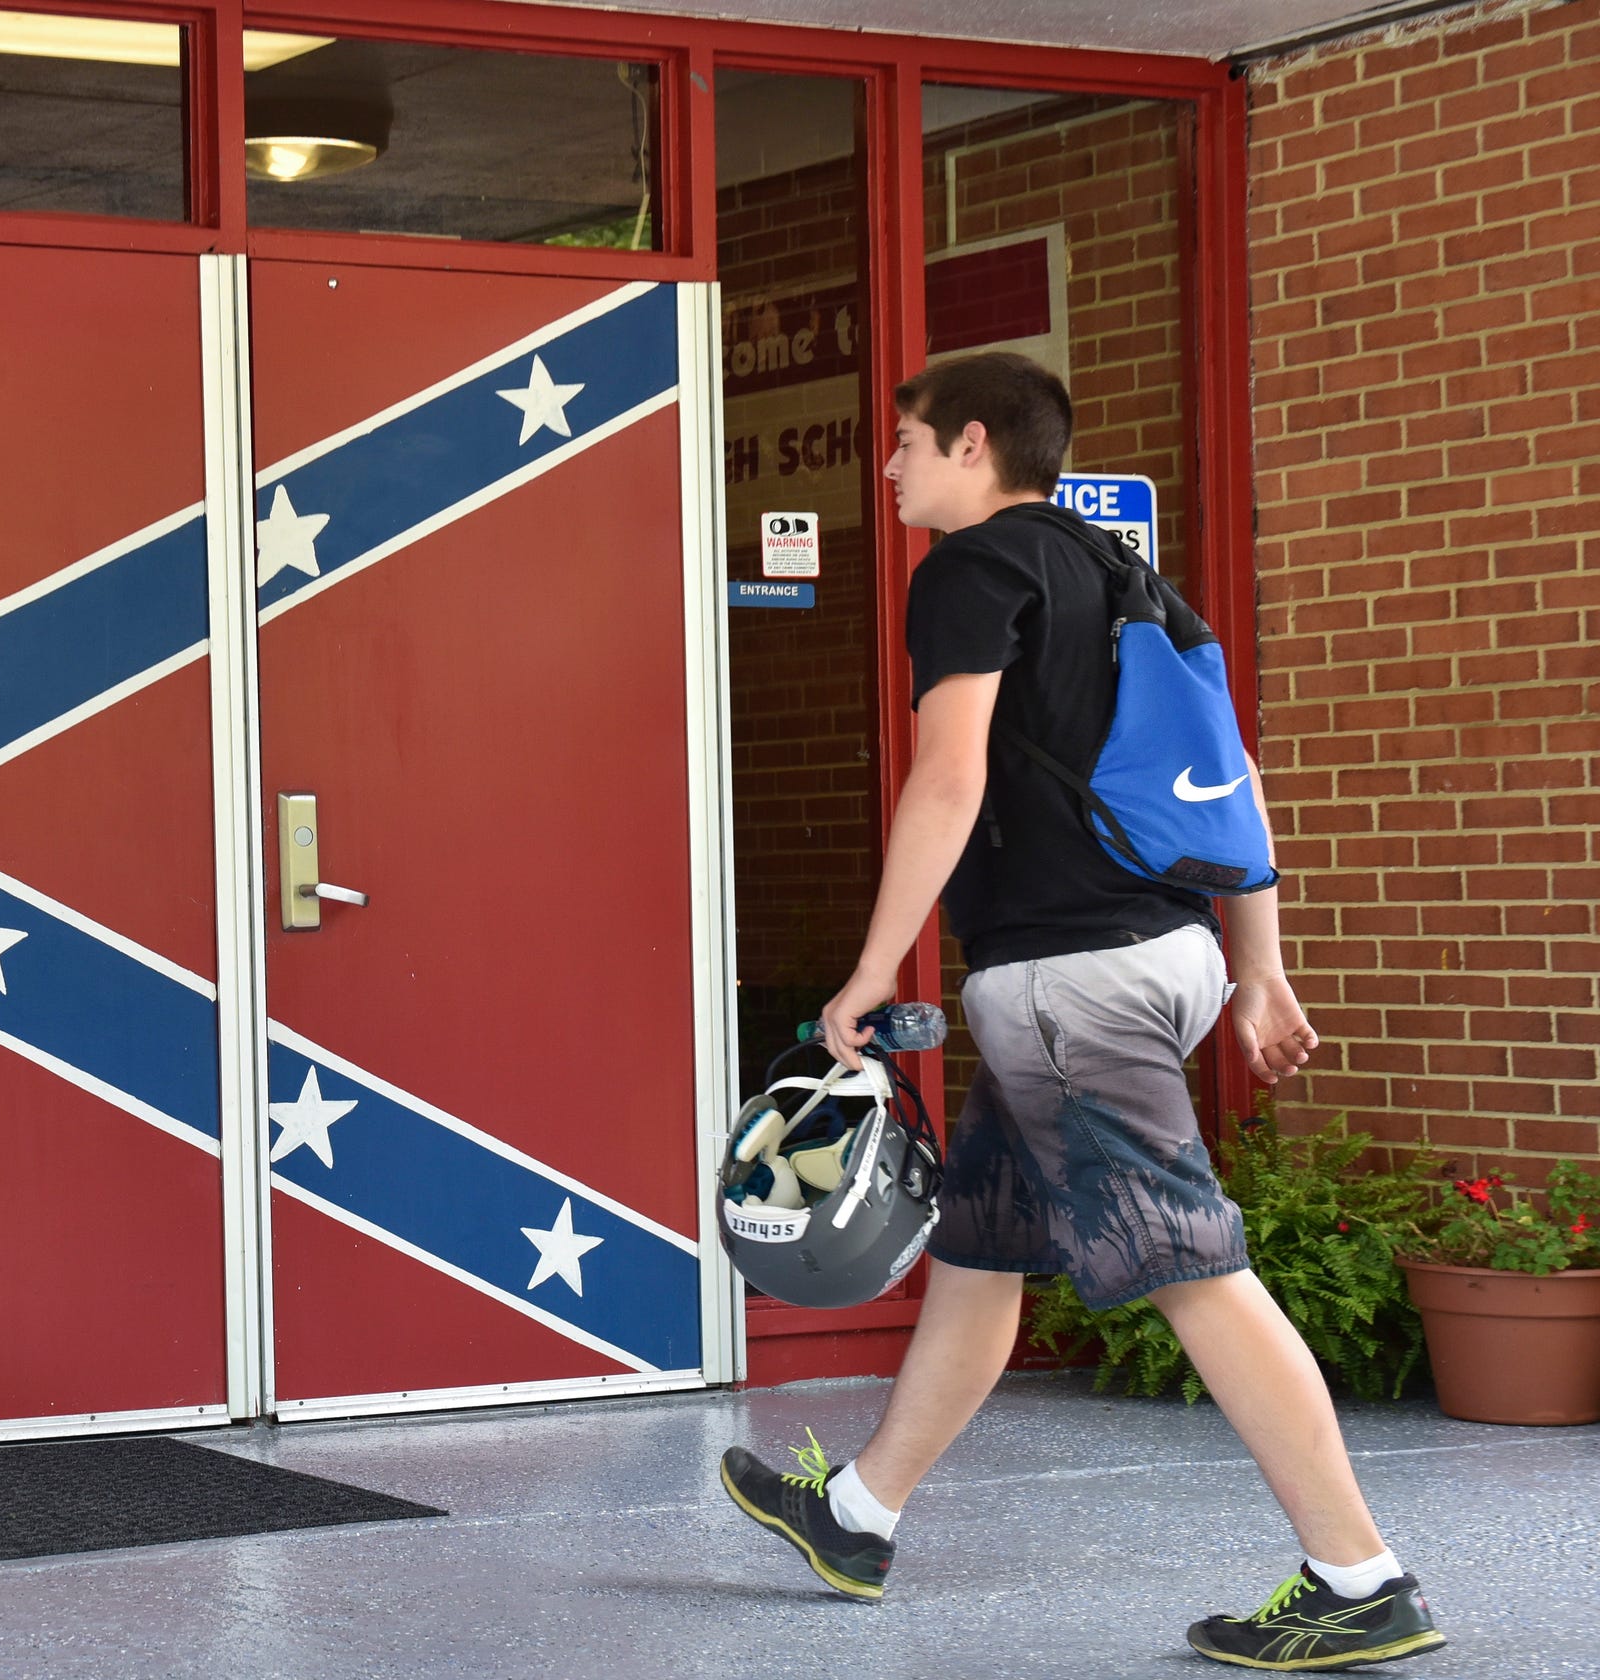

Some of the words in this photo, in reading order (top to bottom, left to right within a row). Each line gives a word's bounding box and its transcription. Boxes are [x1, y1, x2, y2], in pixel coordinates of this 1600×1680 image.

[834, 305, 859, 356] t
[767, 537, 814, 549] WARNING
[740, 585, 798, 597] ENTRANCE
